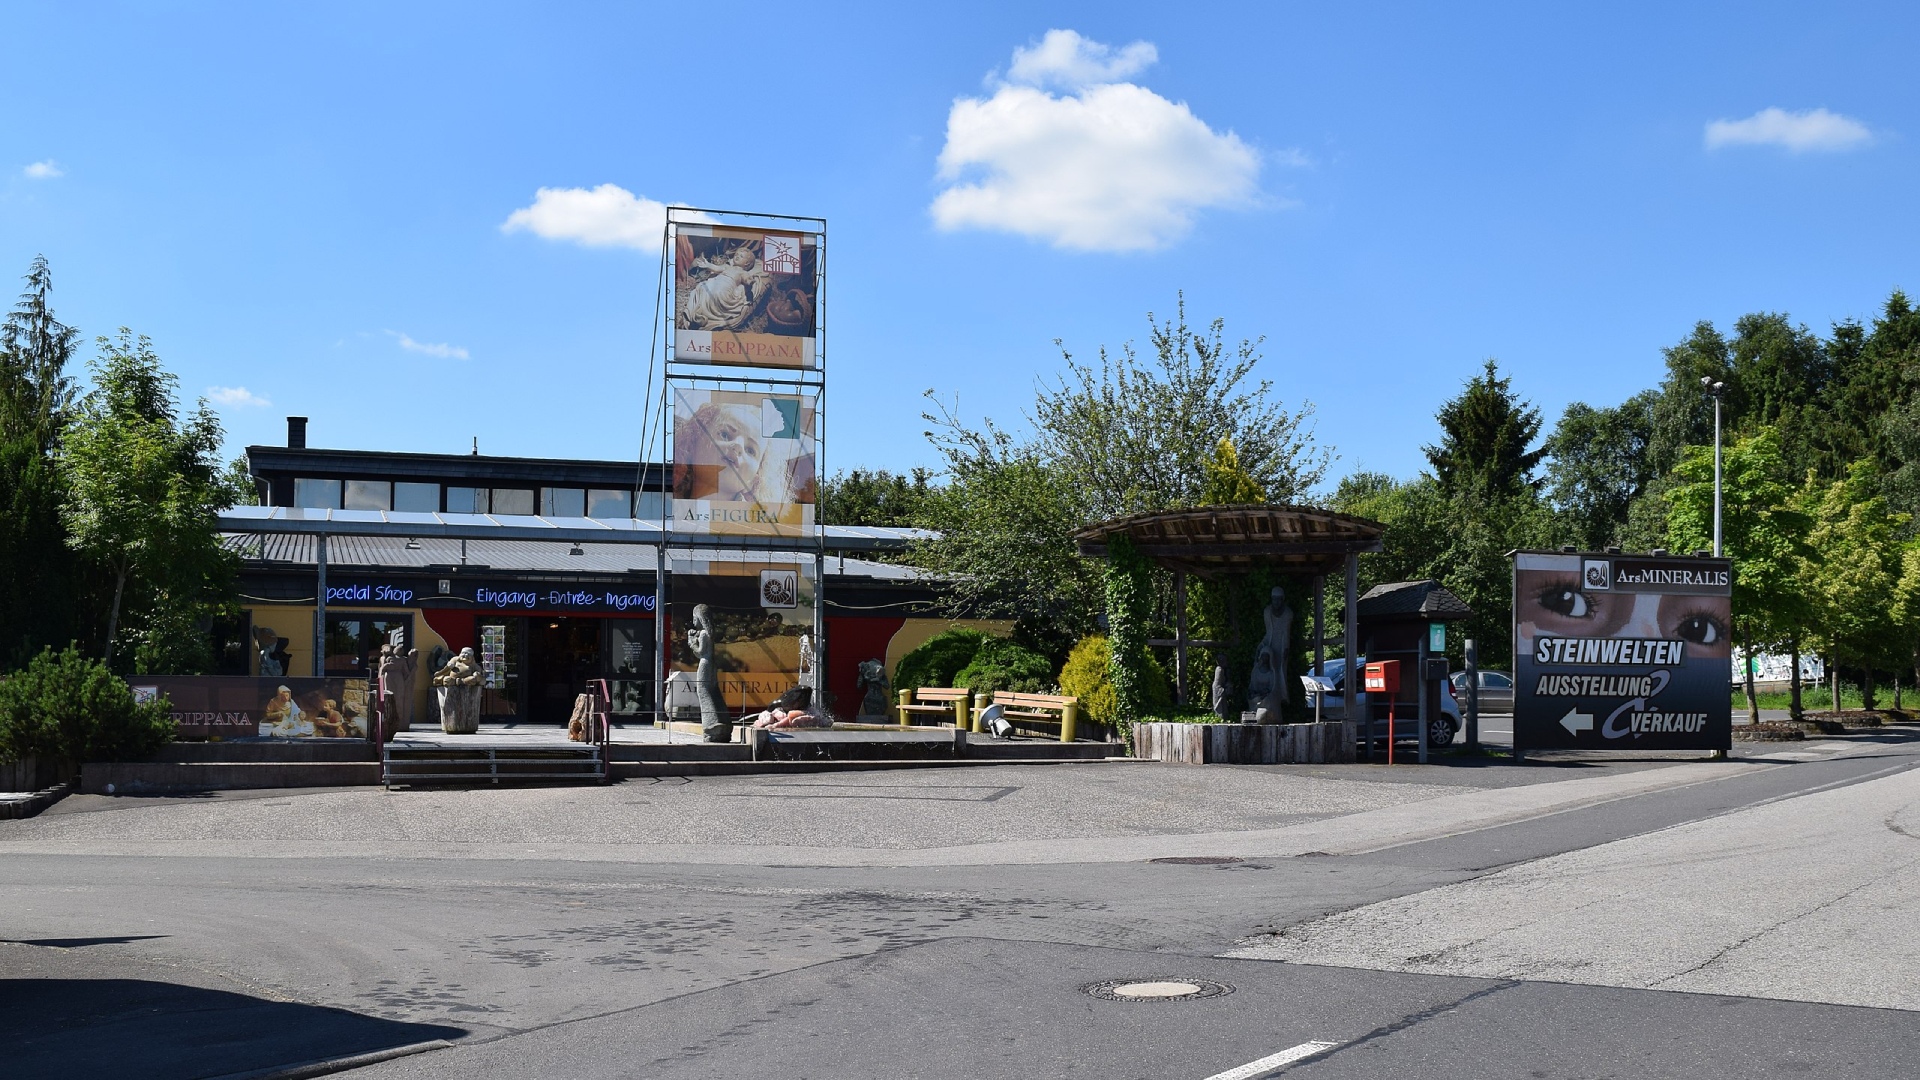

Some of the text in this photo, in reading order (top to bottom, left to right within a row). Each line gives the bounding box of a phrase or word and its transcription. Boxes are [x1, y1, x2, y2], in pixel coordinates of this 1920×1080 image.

[686, 339, 801, 358] ArsKRIPPANA
[684, 507, 780, 524] ArsFIGURA
[1616, 568, 1729, 586] ArsMINERALIS
[326, 584, 413, 605] pecial Shop
[476, 588, 537, 608] Eingang
[606, 592, 657, 611] Ingang
[1536, 638, 1684, 665] STEINWELTEN
[1536, 675, 1652, 697] AUSSTELLUNG
[169, 712, 252, 726] RIPPANA
[1630, 712, 1708, 733] VERKAUF
